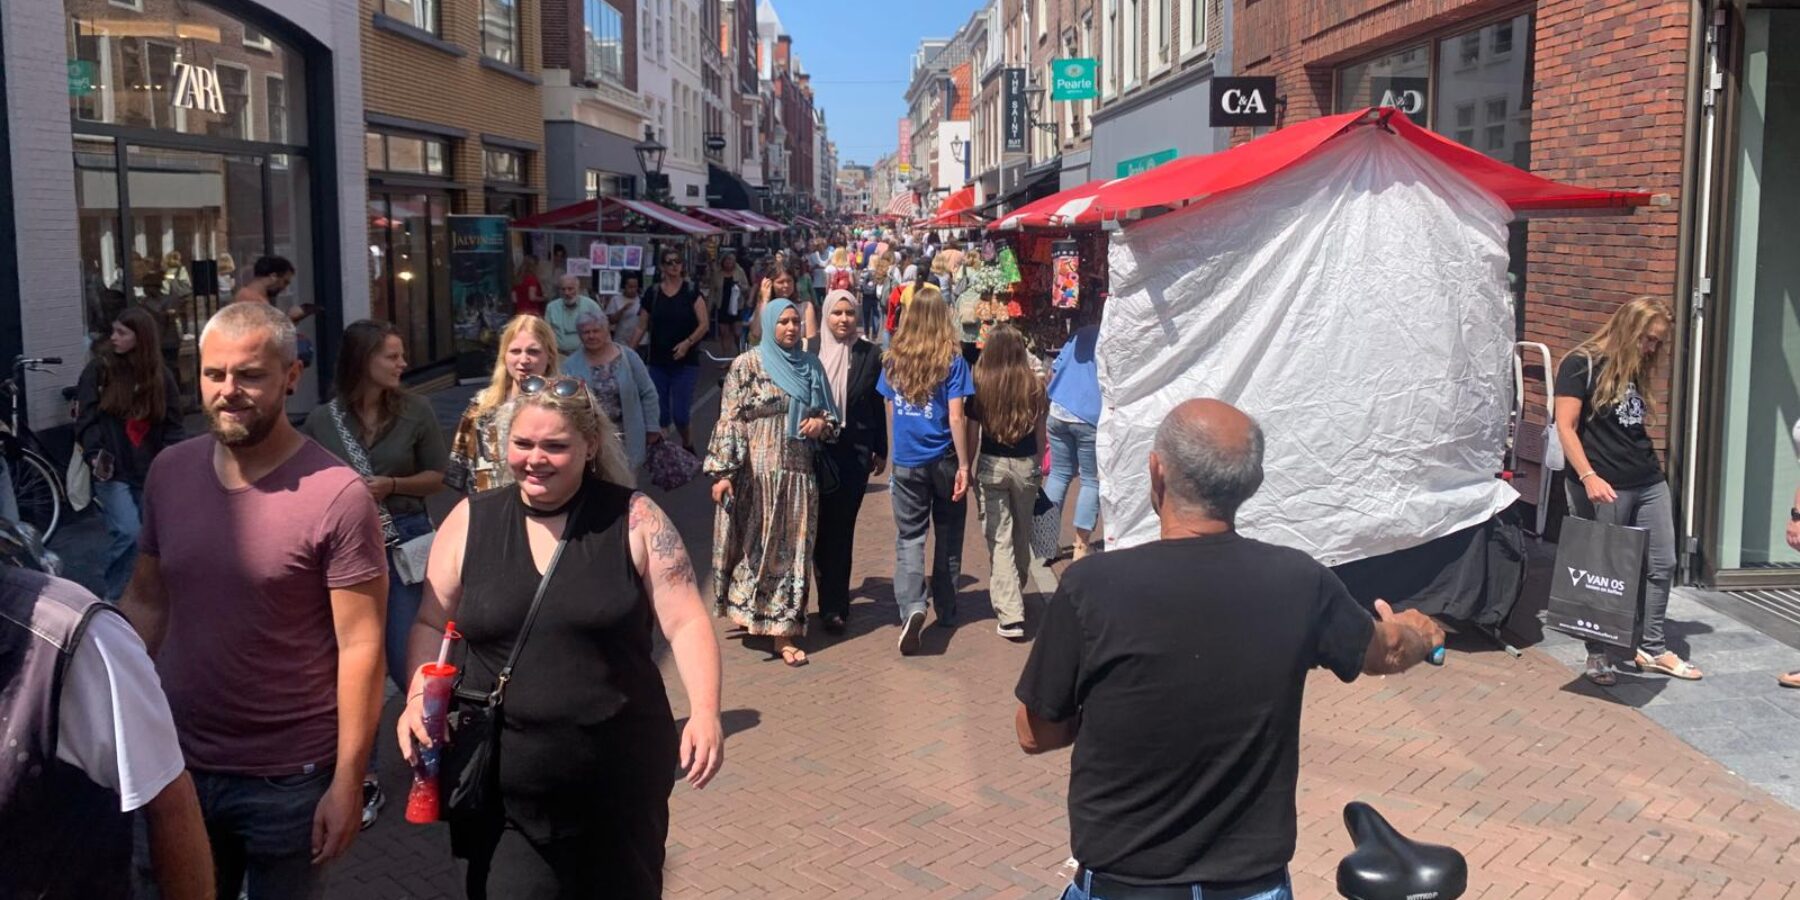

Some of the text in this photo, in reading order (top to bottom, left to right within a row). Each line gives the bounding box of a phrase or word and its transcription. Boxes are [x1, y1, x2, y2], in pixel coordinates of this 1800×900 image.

[172, 61, 227, 114] ZARA
[1011, 71, 1019, 95] THE
[1057, 78, 1092, 90] Pearle
[1221, 88, 1267, 114] C&A
[1011, 100, 1019, 138] SAINT
[1586, 573, 1625, 591] VAN OS
